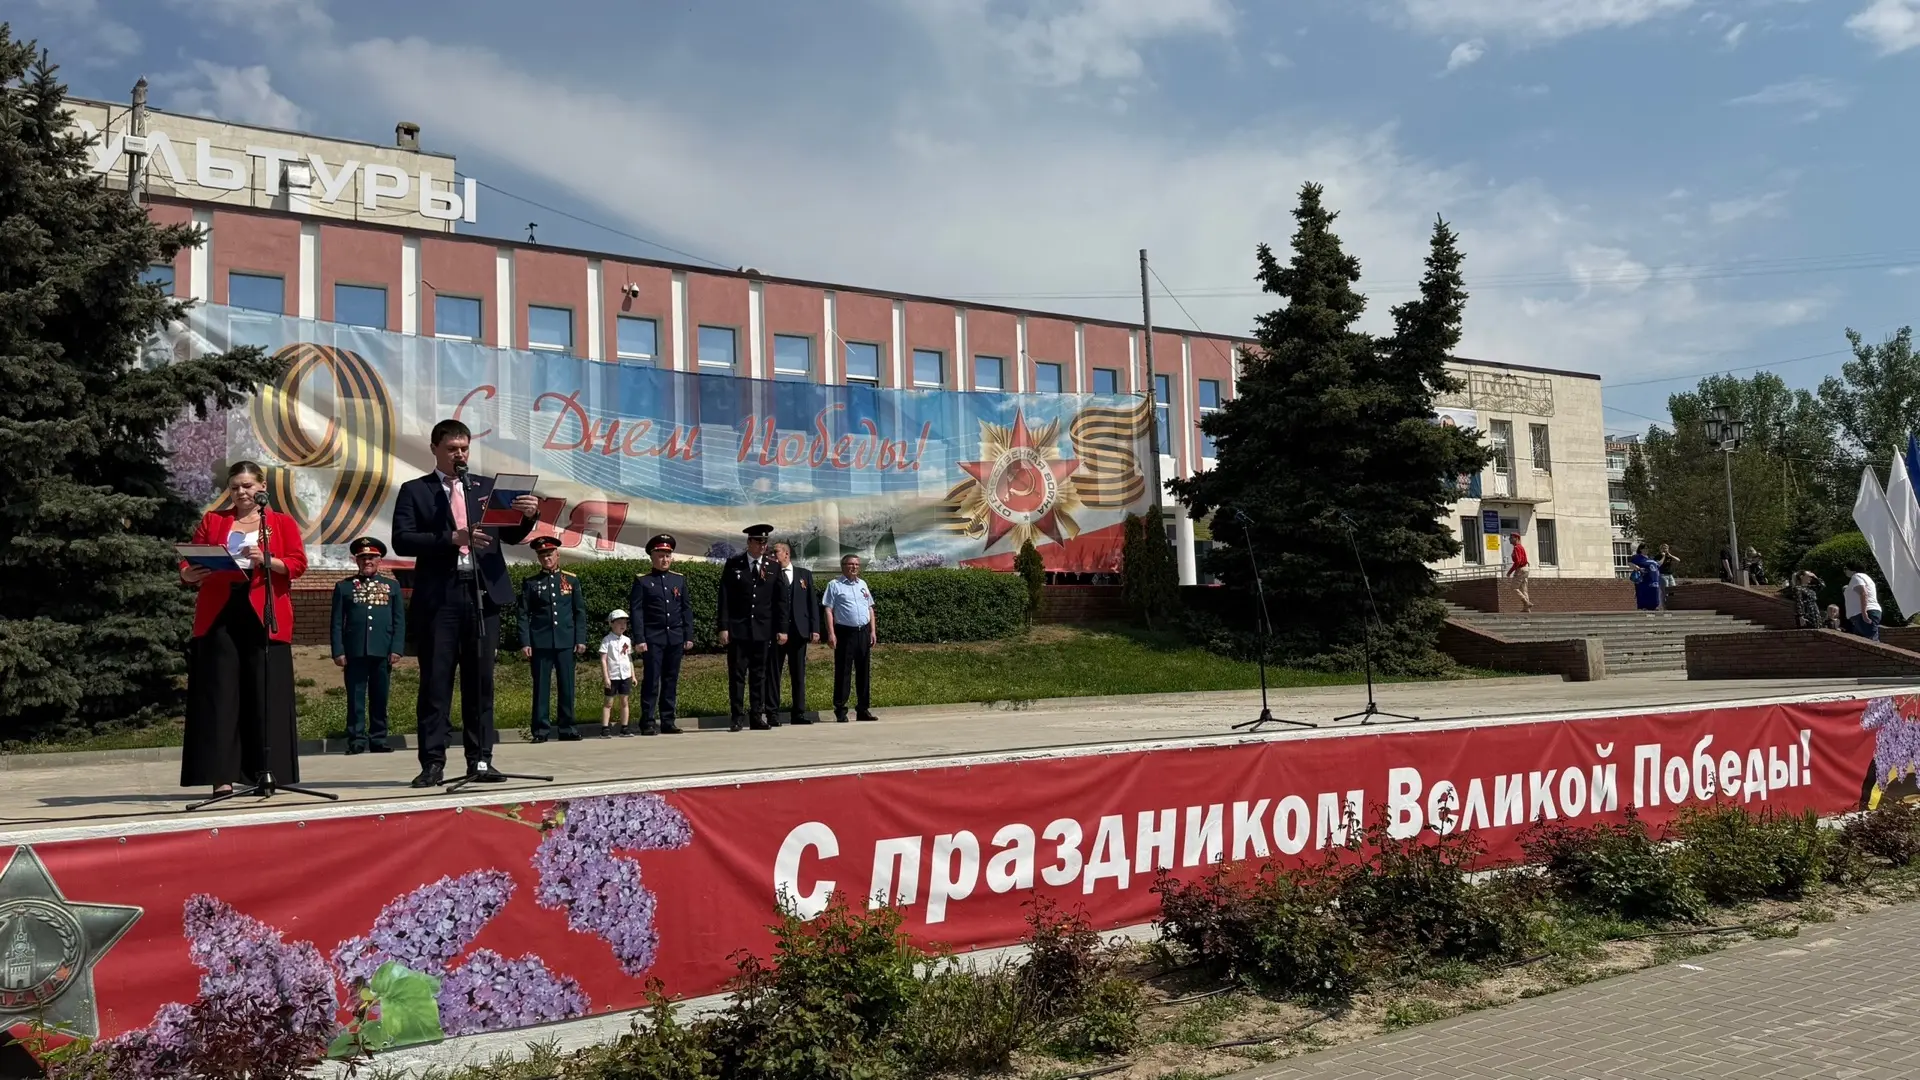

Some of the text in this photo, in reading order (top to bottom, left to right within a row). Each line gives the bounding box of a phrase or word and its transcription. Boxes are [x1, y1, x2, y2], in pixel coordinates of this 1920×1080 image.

[452, 384, 932, 471] С Днем Победы!
[773, 729, 1812, 925] С праздником Великой Победы!
